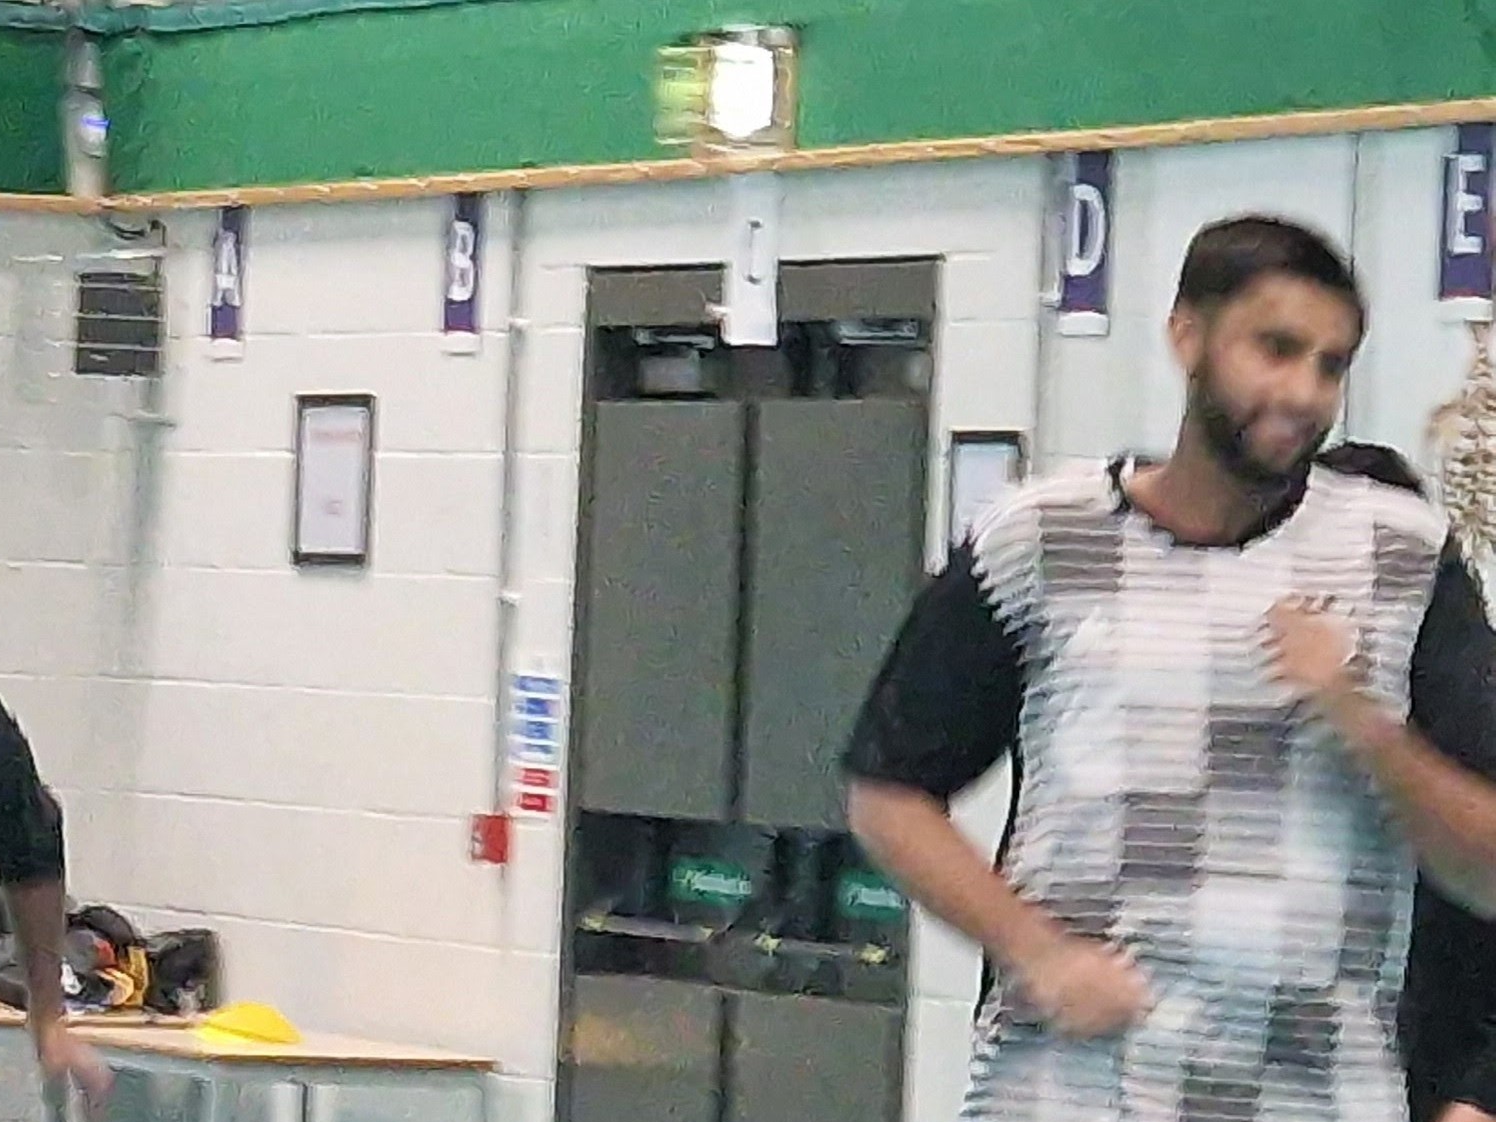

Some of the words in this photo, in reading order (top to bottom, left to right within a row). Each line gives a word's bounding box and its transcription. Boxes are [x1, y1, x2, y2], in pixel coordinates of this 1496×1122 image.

[1065, 182, 1108, 277] D
[1446, 152, 1487, 257] E
[212, 226, 241, 307] A
[445, 219, 476, 302] B
